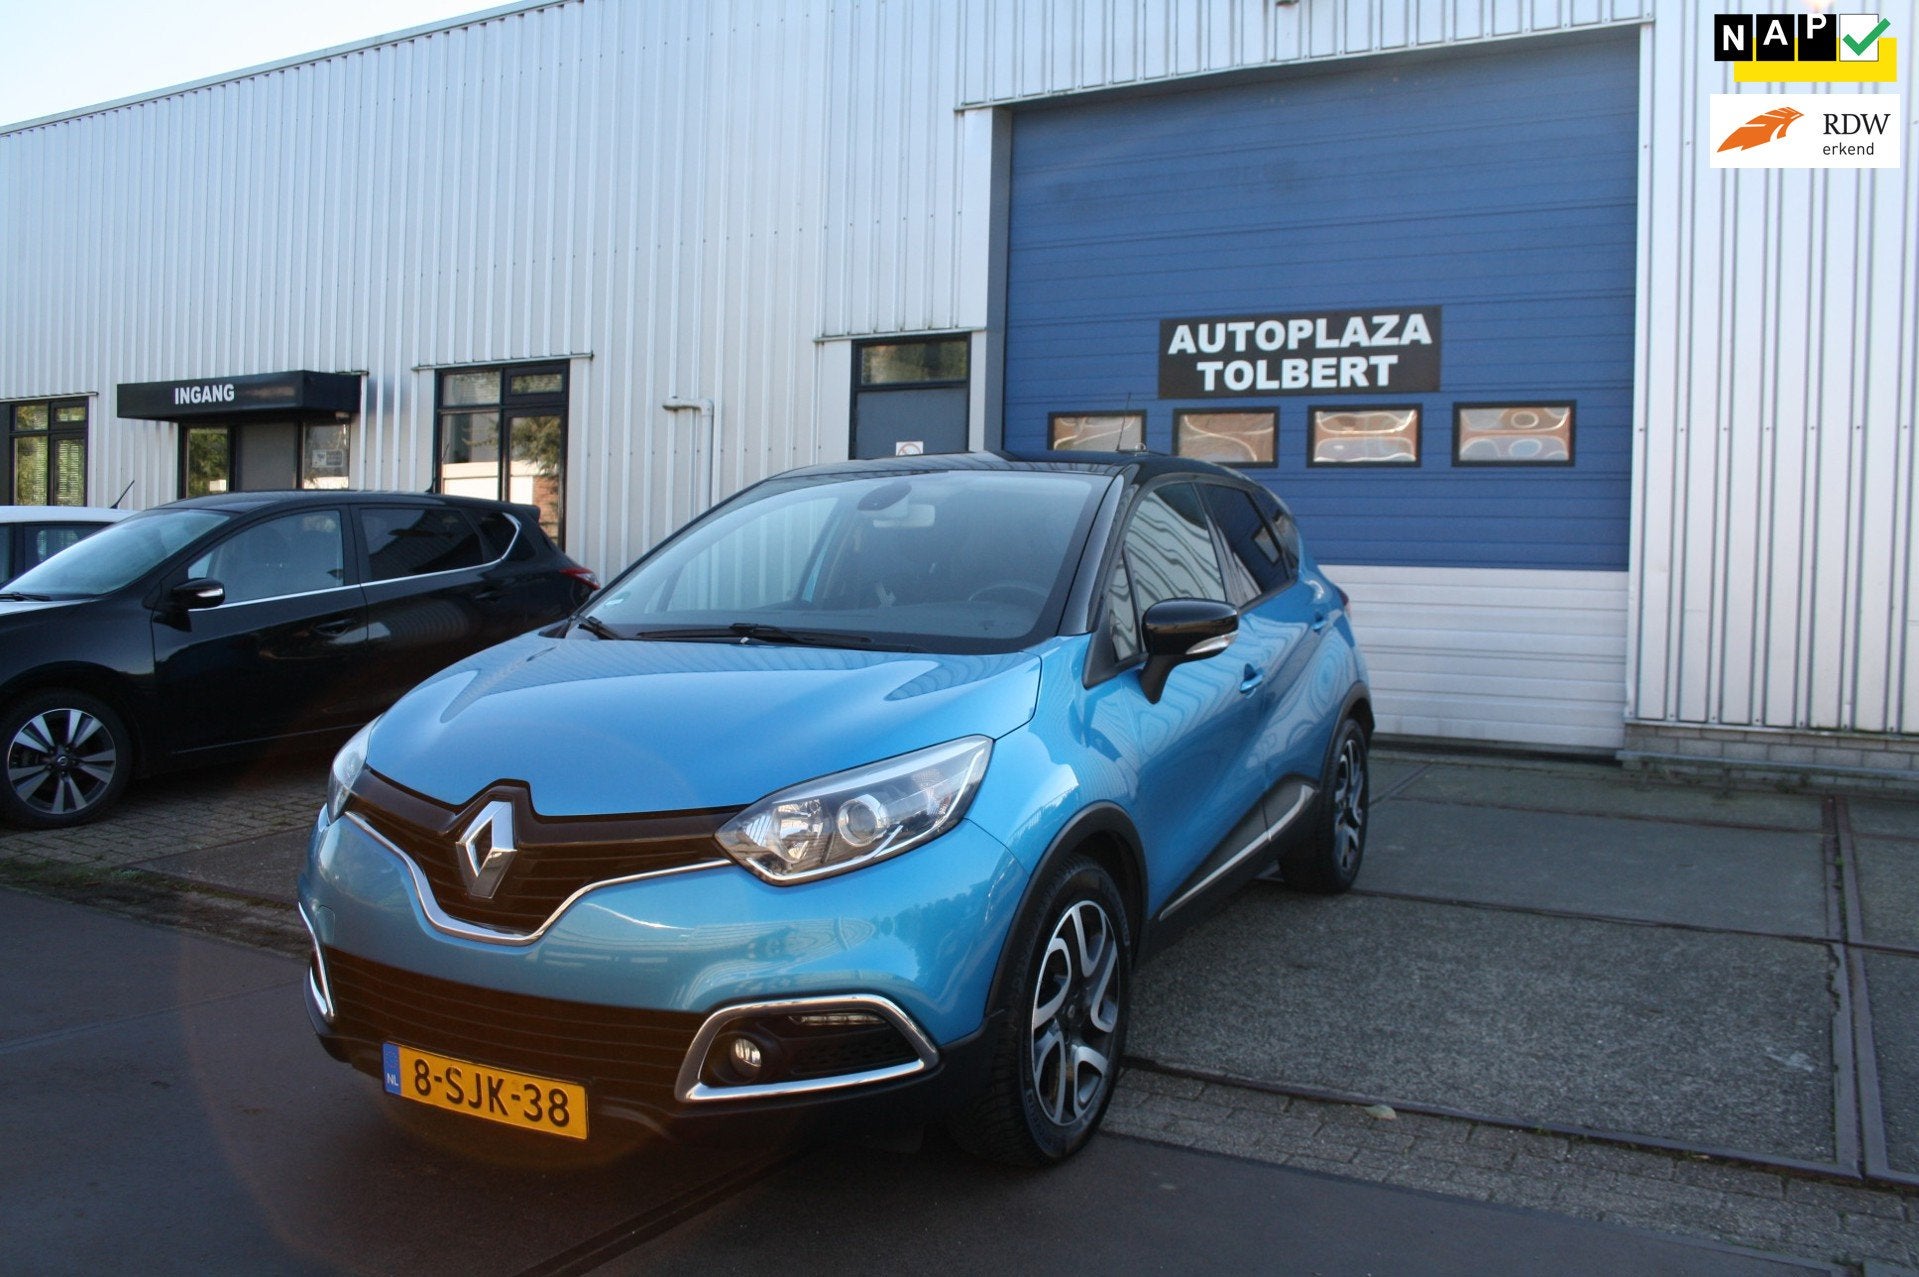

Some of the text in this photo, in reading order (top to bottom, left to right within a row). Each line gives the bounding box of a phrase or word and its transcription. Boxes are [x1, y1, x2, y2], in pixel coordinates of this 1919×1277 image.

[1168, 313, 1433, 355] AUTOPLAZA
[1196, 355, 1398, 392] TOLBERT
[174, 383, 235, 405] INGANG
[386, 1072, 399, 1087] NL
[414, 1058, 570, 1127] 8-SJK-38
